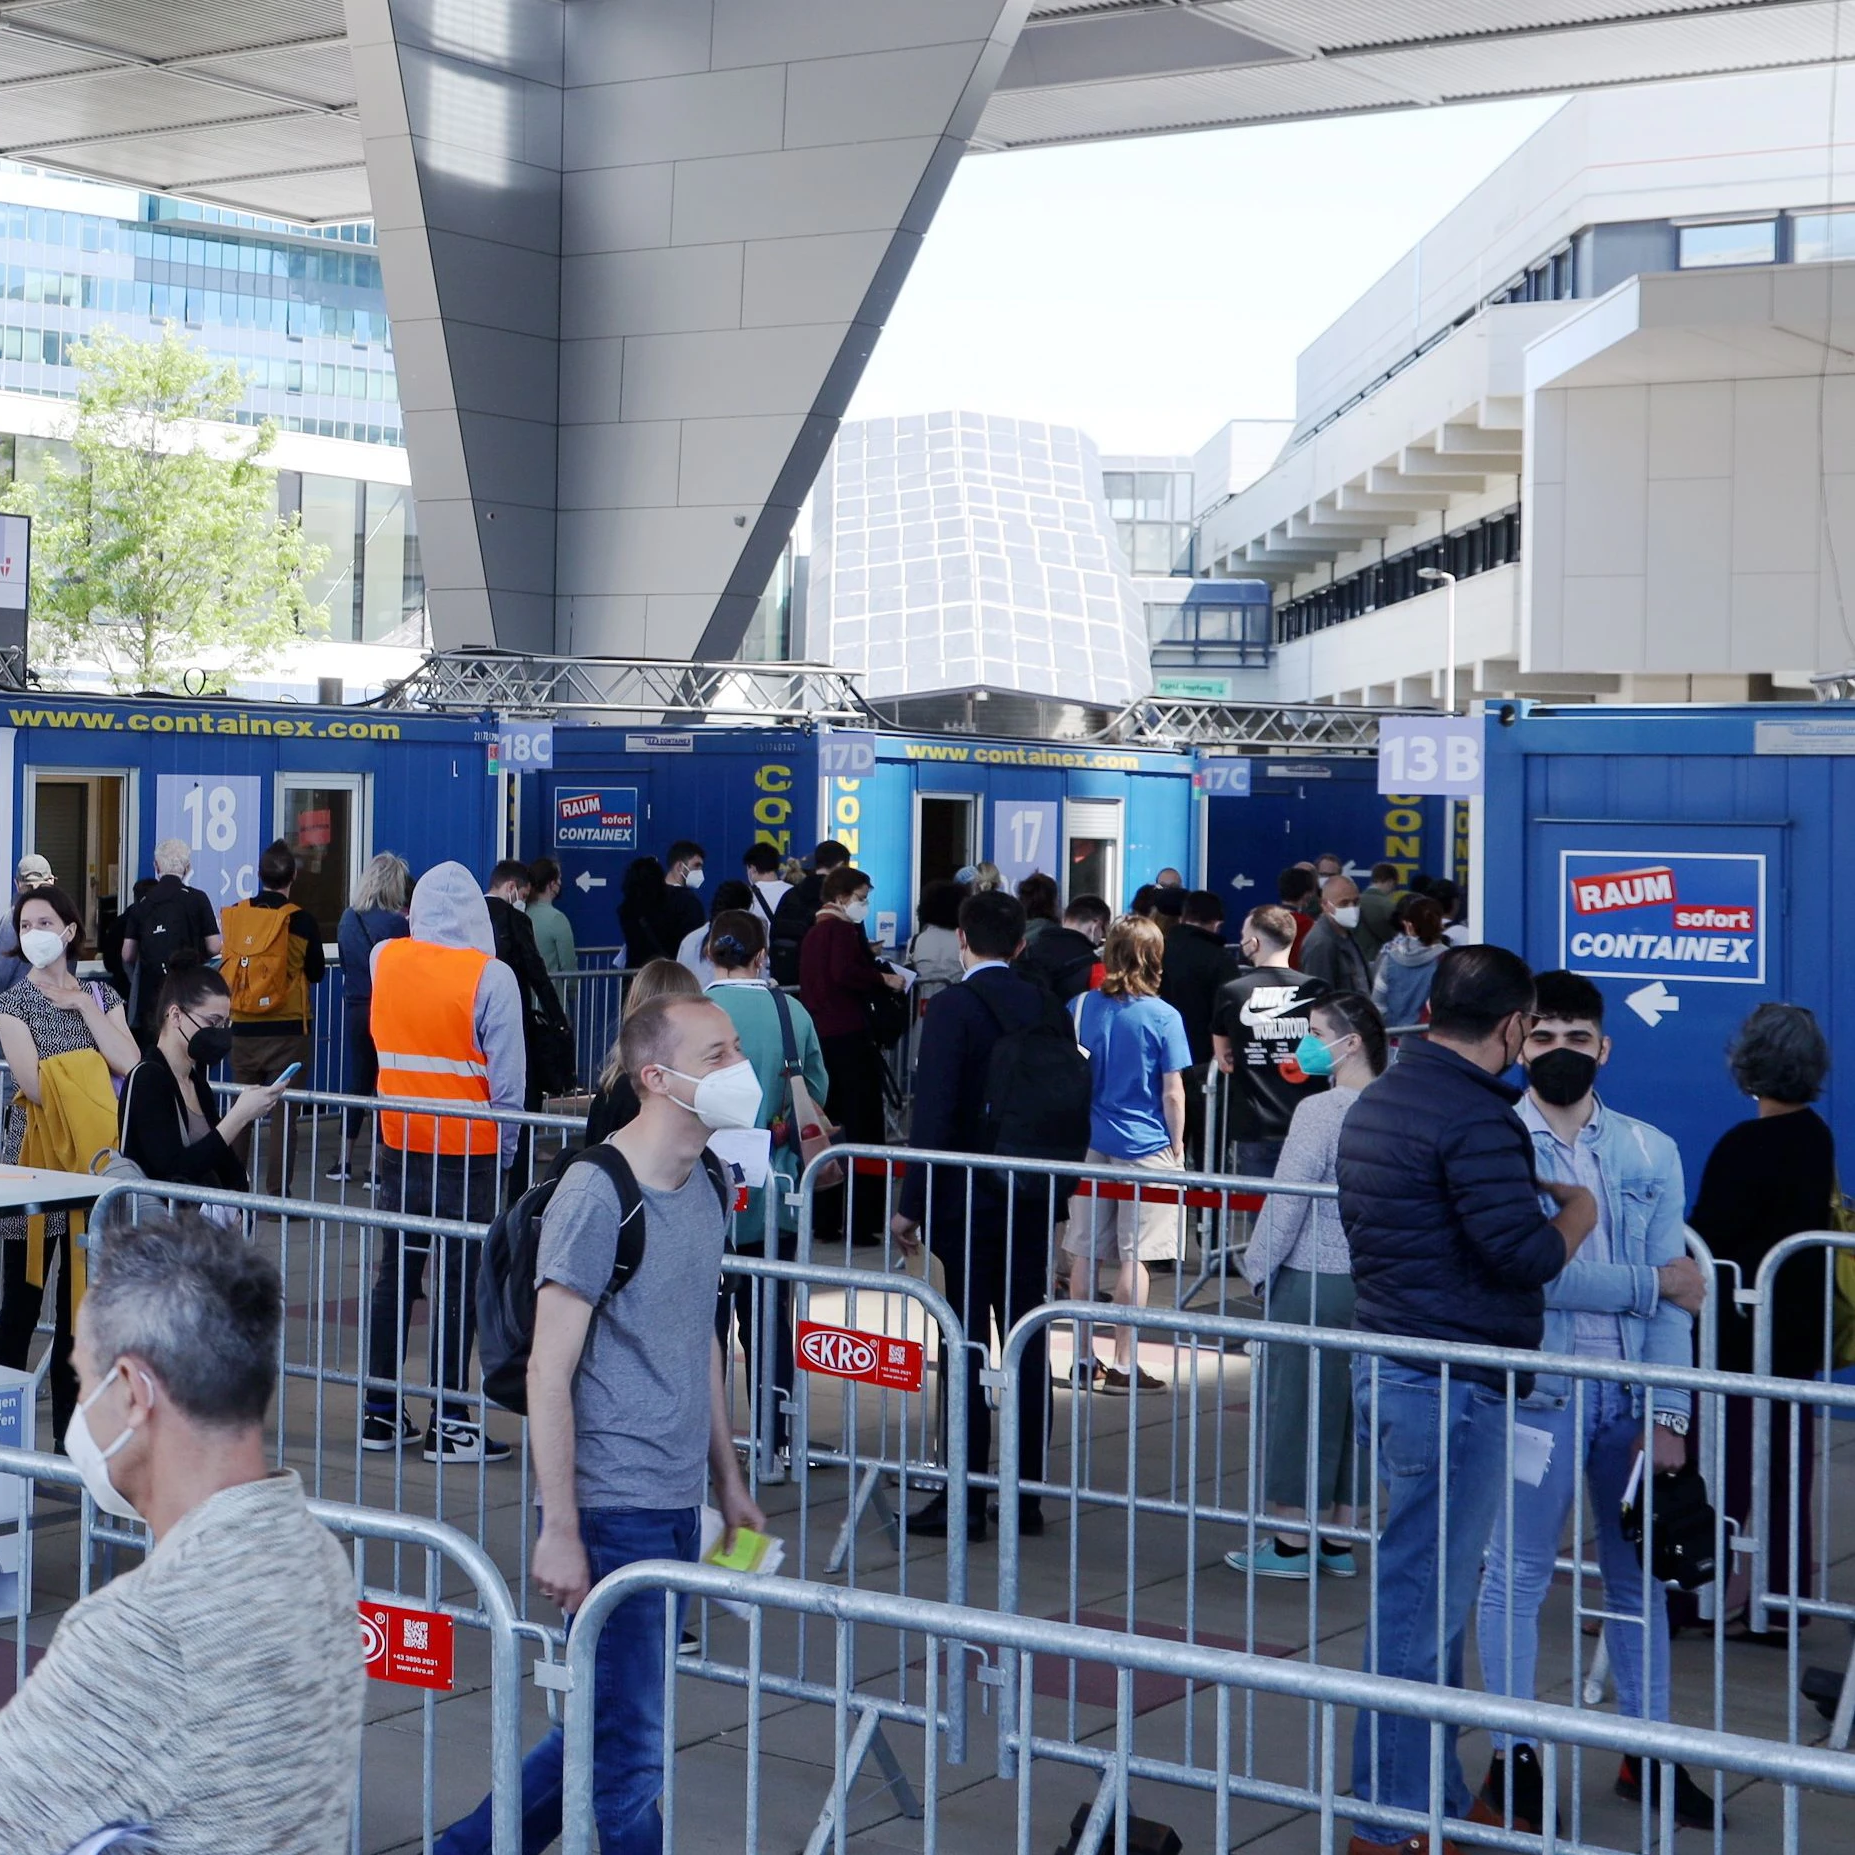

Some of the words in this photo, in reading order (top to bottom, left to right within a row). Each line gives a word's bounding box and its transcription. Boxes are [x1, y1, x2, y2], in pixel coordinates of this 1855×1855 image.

[8, 709, 400, 740] www.containex.com
[501, 733, 550, 761] 18C
[822, 743, 874, 770] 17D
[1202, 766, 1247, 791] 17C
[183, 786, 237, 852] 18
[562, 797, 600, 817] RAUM
[601, 815, 632, 825] sofort
[559, 828, 632, 842] CONTAINEX
[1010, 810, 1043, 863] 17
[1579, 874, 1673, 911] RAUM
[1676, 909, 1750, 929] sofort
[1571, 932, 1753, 963] CONTAINEX
[1249, 986, 1299, 1009] NIKE
[804, 1334, 871, 1370] EKRO
[393, 1653, 405, 1661] +43
[396, 1664, 434, 1675] www.ekro.at
